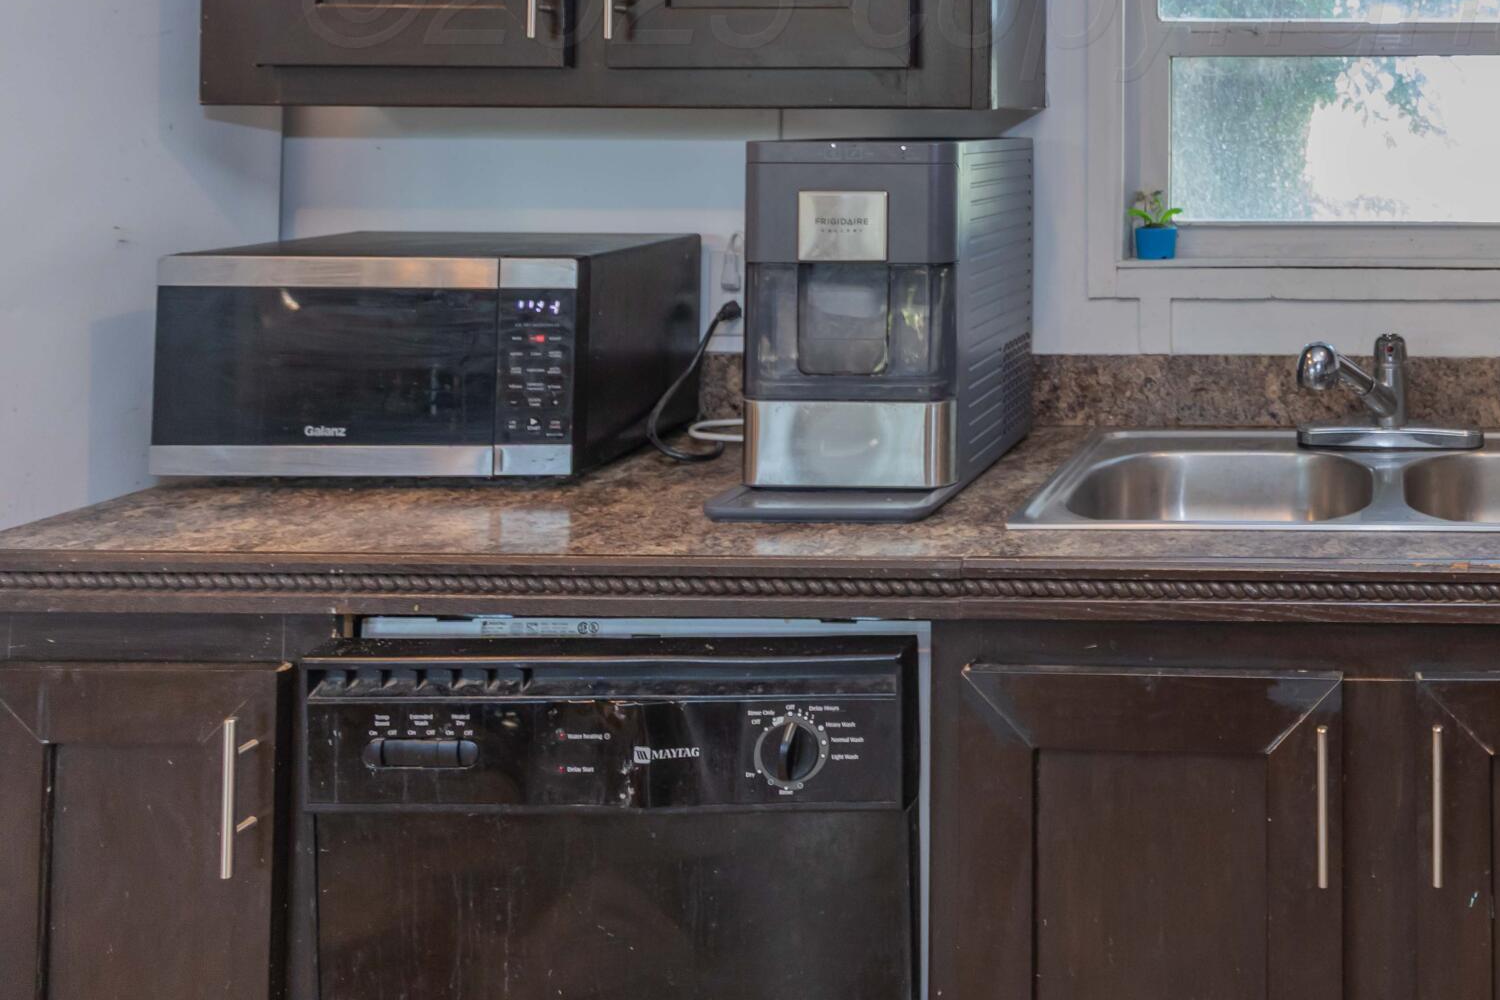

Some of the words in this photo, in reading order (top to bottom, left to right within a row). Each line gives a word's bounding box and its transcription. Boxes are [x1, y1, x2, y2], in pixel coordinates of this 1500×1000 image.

[815, 217, 870, 226] FRIGIDAIRE
[304, 425, 347, 437] Galanz
[652, 747, 700, 760] MAYTAG
